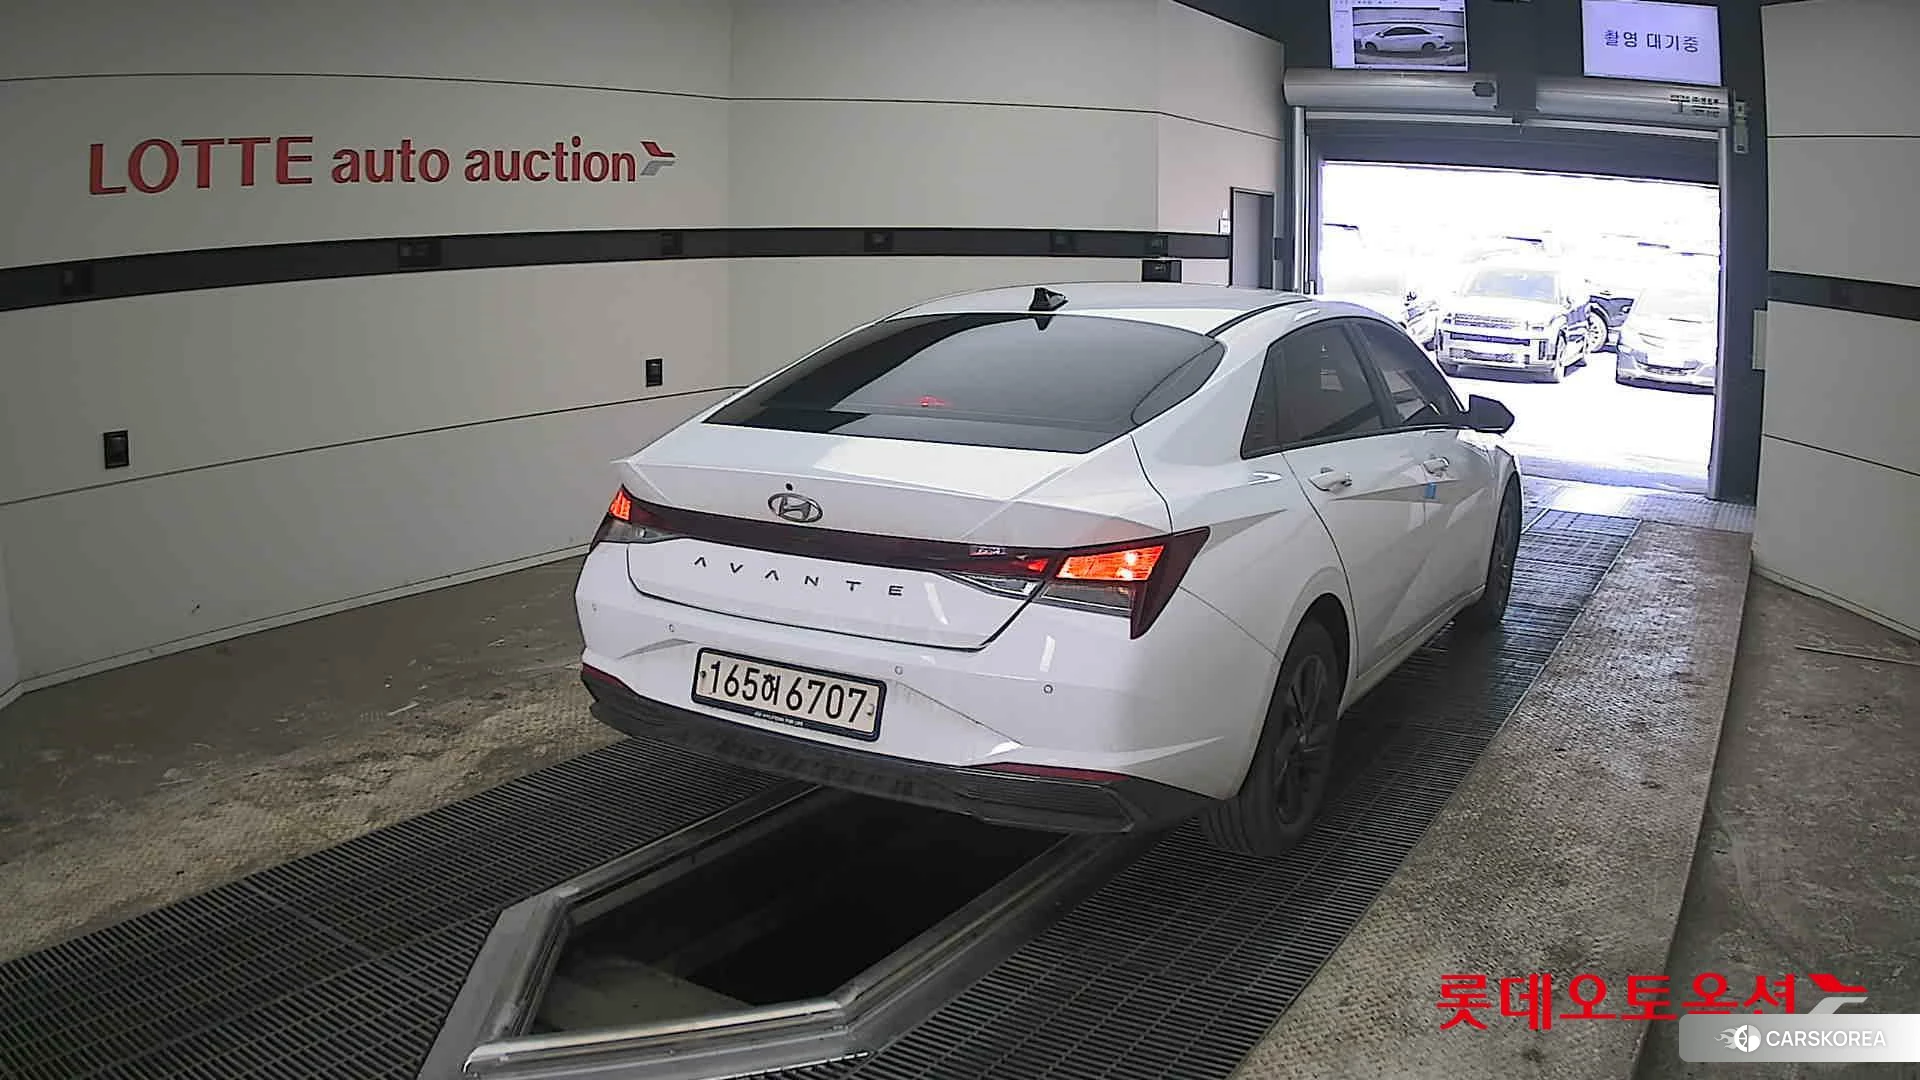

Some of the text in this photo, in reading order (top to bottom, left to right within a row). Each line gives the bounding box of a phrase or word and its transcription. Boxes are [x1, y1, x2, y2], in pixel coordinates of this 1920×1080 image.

[1646, 32, 1700, 53] 대기중
[89, 135, 637, 195] LOTTE auto auction
[694, 556, 904, 597] AVANTE
[710, 661, 867, 723] 165허6707
